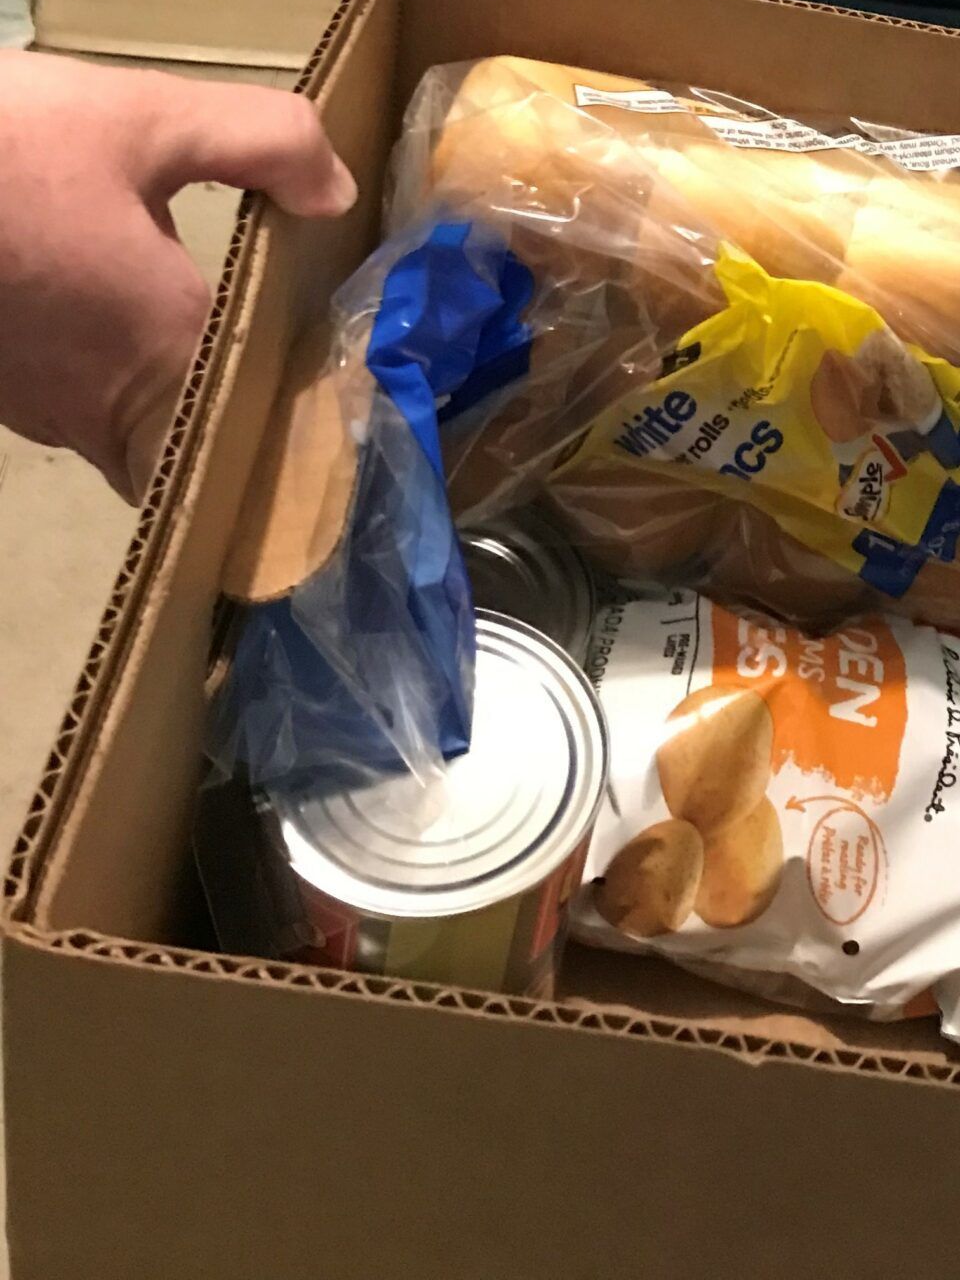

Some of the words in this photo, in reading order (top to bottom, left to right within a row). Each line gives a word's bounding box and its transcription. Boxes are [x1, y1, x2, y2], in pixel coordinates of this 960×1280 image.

[613, 391, 697, 457] white
[688, 414, 730, 459] rolls
[737, 617, 788, 678] ES
